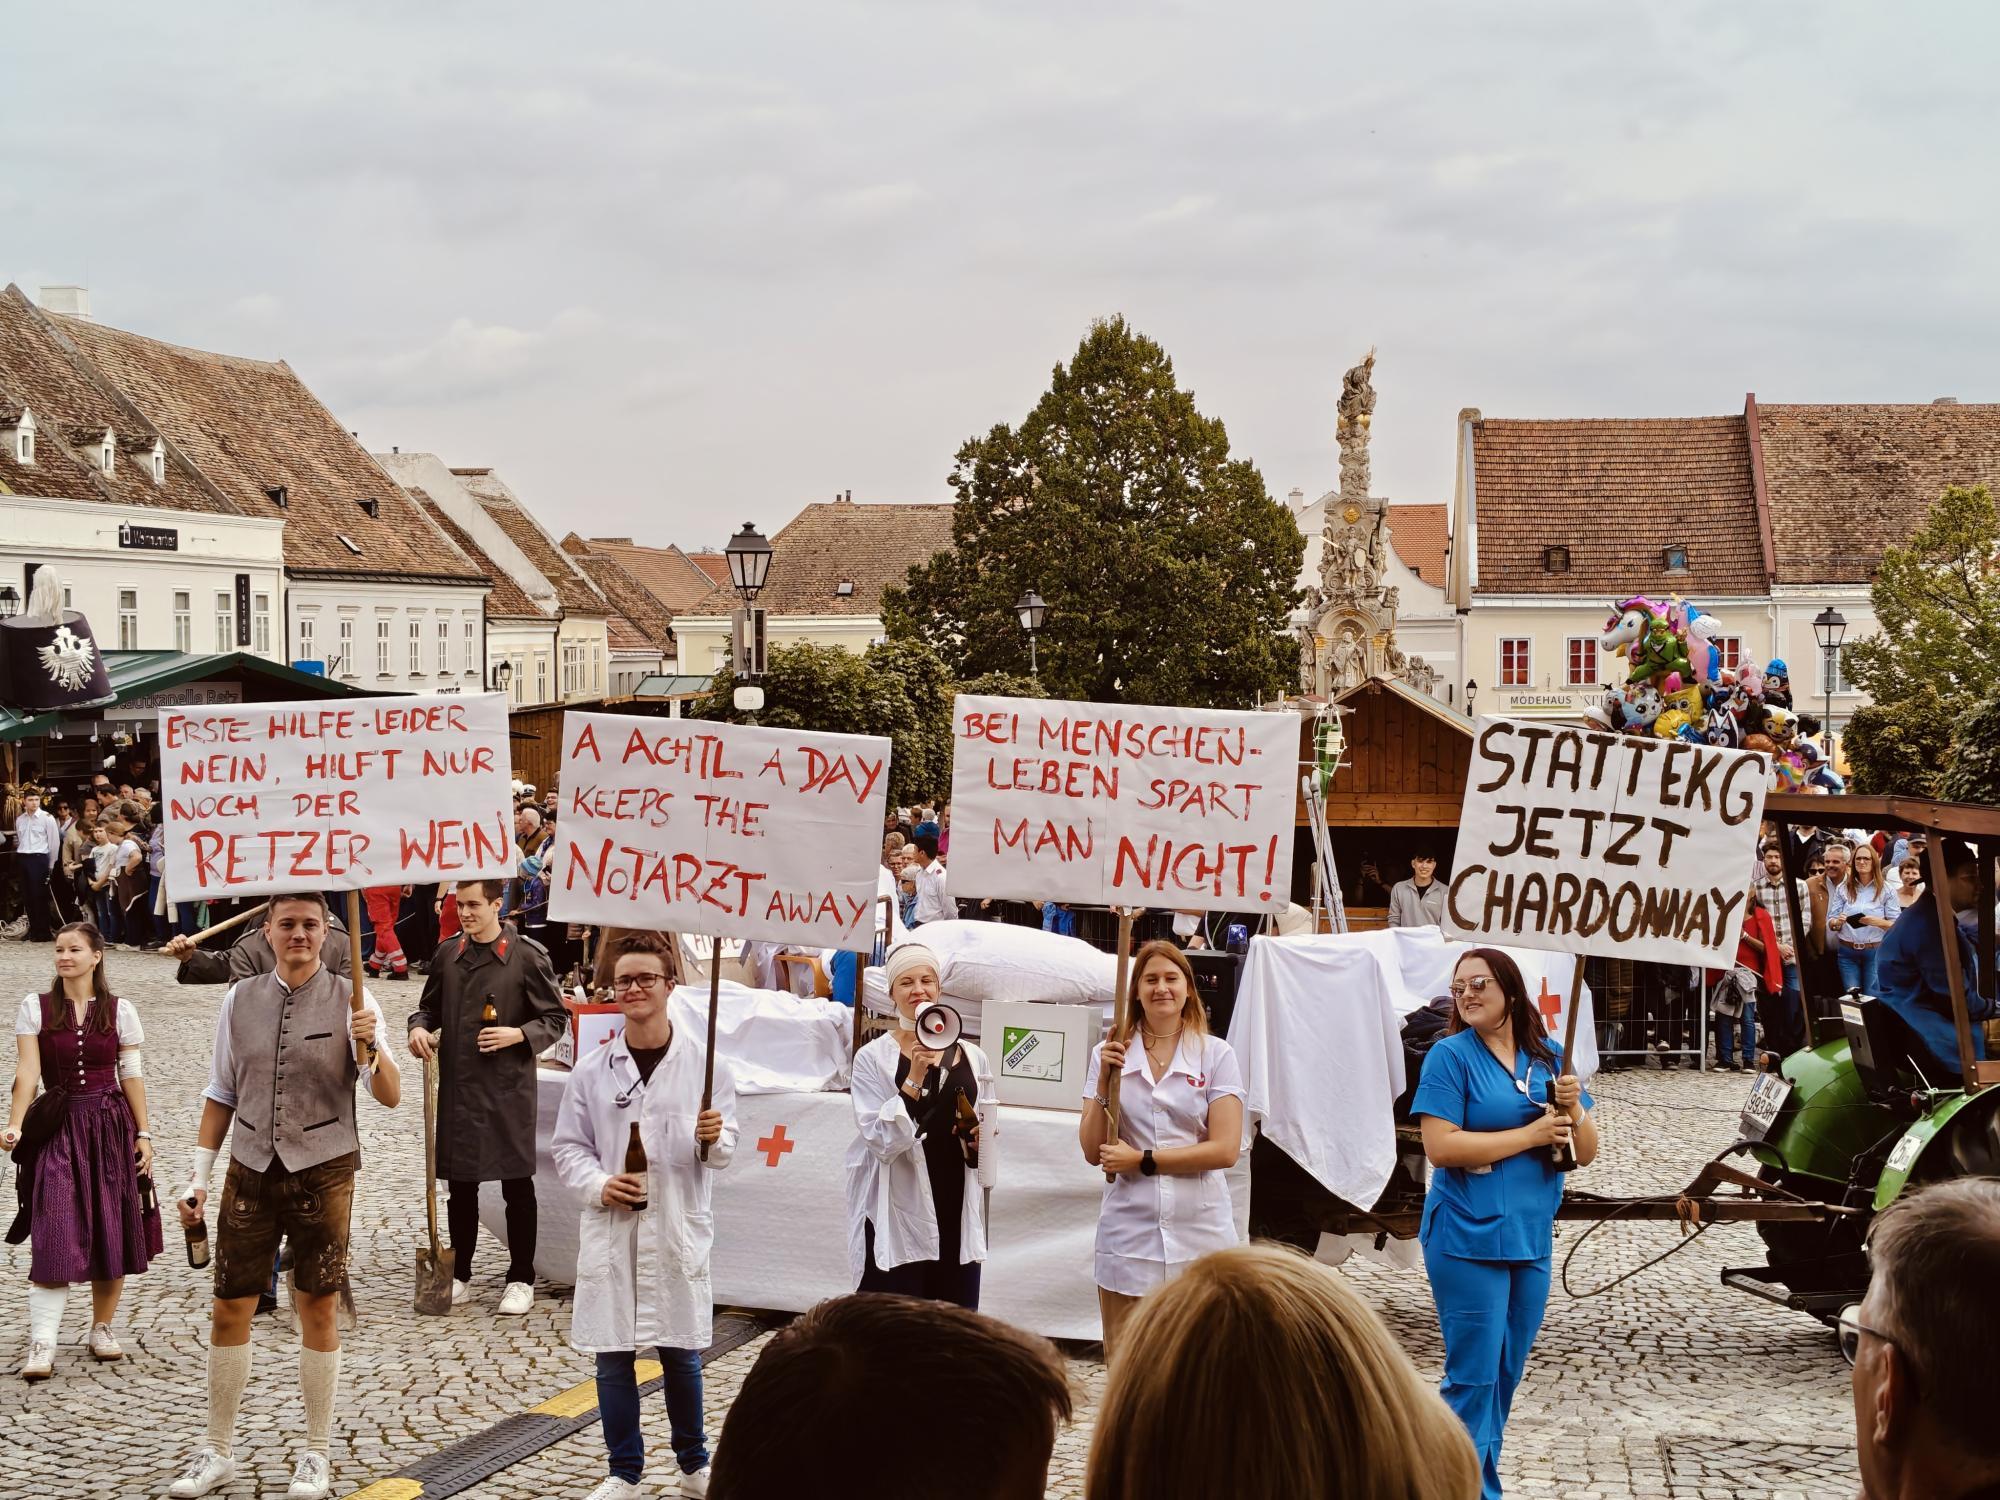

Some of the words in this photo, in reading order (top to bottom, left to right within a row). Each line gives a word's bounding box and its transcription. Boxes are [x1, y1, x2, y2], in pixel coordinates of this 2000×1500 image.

[1510, 695, 1572, 705] MODEHAUS
[166, 715, 252, 750] ERSTE
[960, 712, 1018, 744] BEI
[1038, 716, 1262, 766] MENSCHEN-
[180, 753, 279, 784] NEIN,
[305, 749, 402, 782] HILFT
[422, 746, 494, 777] NUR
[571, 723, 602, 763] A
[621, 728, 744, 780] ACHTL
[758, 748, 787, 786] A
[797, 746, 883, 804] DAY
[988, 756, 1118, 800] LEBEN
[1138, 778, 1262, 822] SPART
[170, 794, 259, 821] NOCH
[293, 790, 360, 818] DER
[573, 785, 675, 828] KEEPS
[694, 794, 770, 837] THE
[188, 829, 373, 889] RETZER
[400, 811, 509, 872] WEIN
[993, 817, 1093, 862] MAN
[1112, 833, 1278, 902] NICHT!
[1488, 804, 1691, 869] JETZT
[765, 889, 869, 942] AWAY
[1448, 863, 1745, 951] CHARDONNAY
[1007, 1050, 1025, 1068] ERSTE
[1747, 1093, 1766, 1117] 993
[1761, 1079, 1776, 1100] HL
